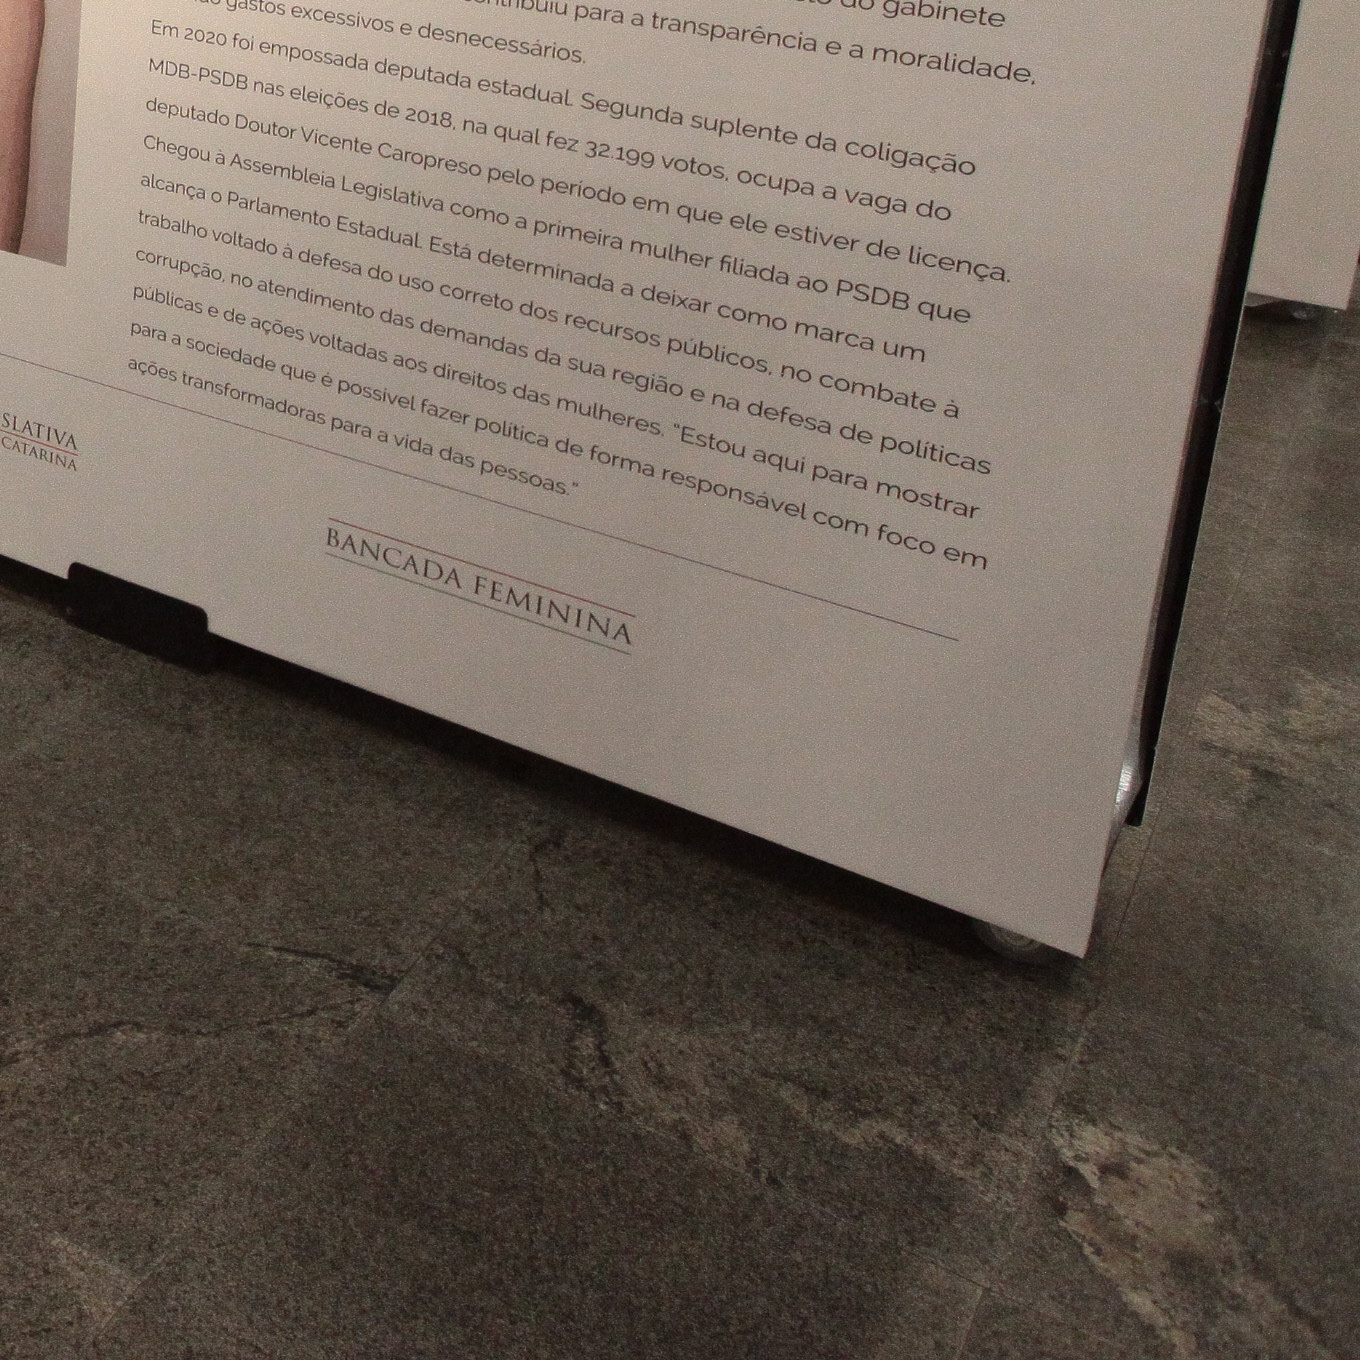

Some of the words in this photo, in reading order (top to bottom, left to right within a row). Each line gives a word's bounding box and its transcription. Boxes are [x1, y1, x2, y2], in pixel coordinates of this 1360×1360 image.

[151, 19, 178, 37] Em
[183, 27, 227, 46] 2020
[232, 32, 253, 50] foi
[258, 41, 368, 70] empossada
[374, 57, 471, 89] deputada
[580, 91, 683, 125] Segunda
[690, 114, 798, 145] suplente
[804, 130, 837, 152] da
[844, 140, 976, 176] coligação
[140, 173, 205, 200] alcança
[210, 190, 222, 203] o
[227, 190, 331, 227] Parlamento
[428, 235, 471, 260] Está
[477, 248, 614, 292] determinada
[620, 282, 634, 296] a
[640, 284, 711, 313] deixar
[716, 304, 787, 331] como
[794, 321, 874, 351] marca
[882, 340, 926, 362] um
[0, 436, 77, 471] CATARINA
[130, 322, 167, 341] para
[171, 333, 181, 345] a
[186, 337, 276, 371] sociedade
[280, 363, 316, 382] que
[320, 372, 333, 387] é
[337, 379, 415, 411] possível
[420, 397, 470, 425] fazer
[473, 416, 549, 448] política
[554, 437, 583, 457] de
[589, 444, 655, 477] forma
[661, 467, 806, 520] responsável
[812, 510, 869, 537] com
[877, 523, 936, 555] foco
[942, 546, 988, 570] em
[325, 526, 461, 589] BANCADA
[473, 574, 632, 645] FEMININA
